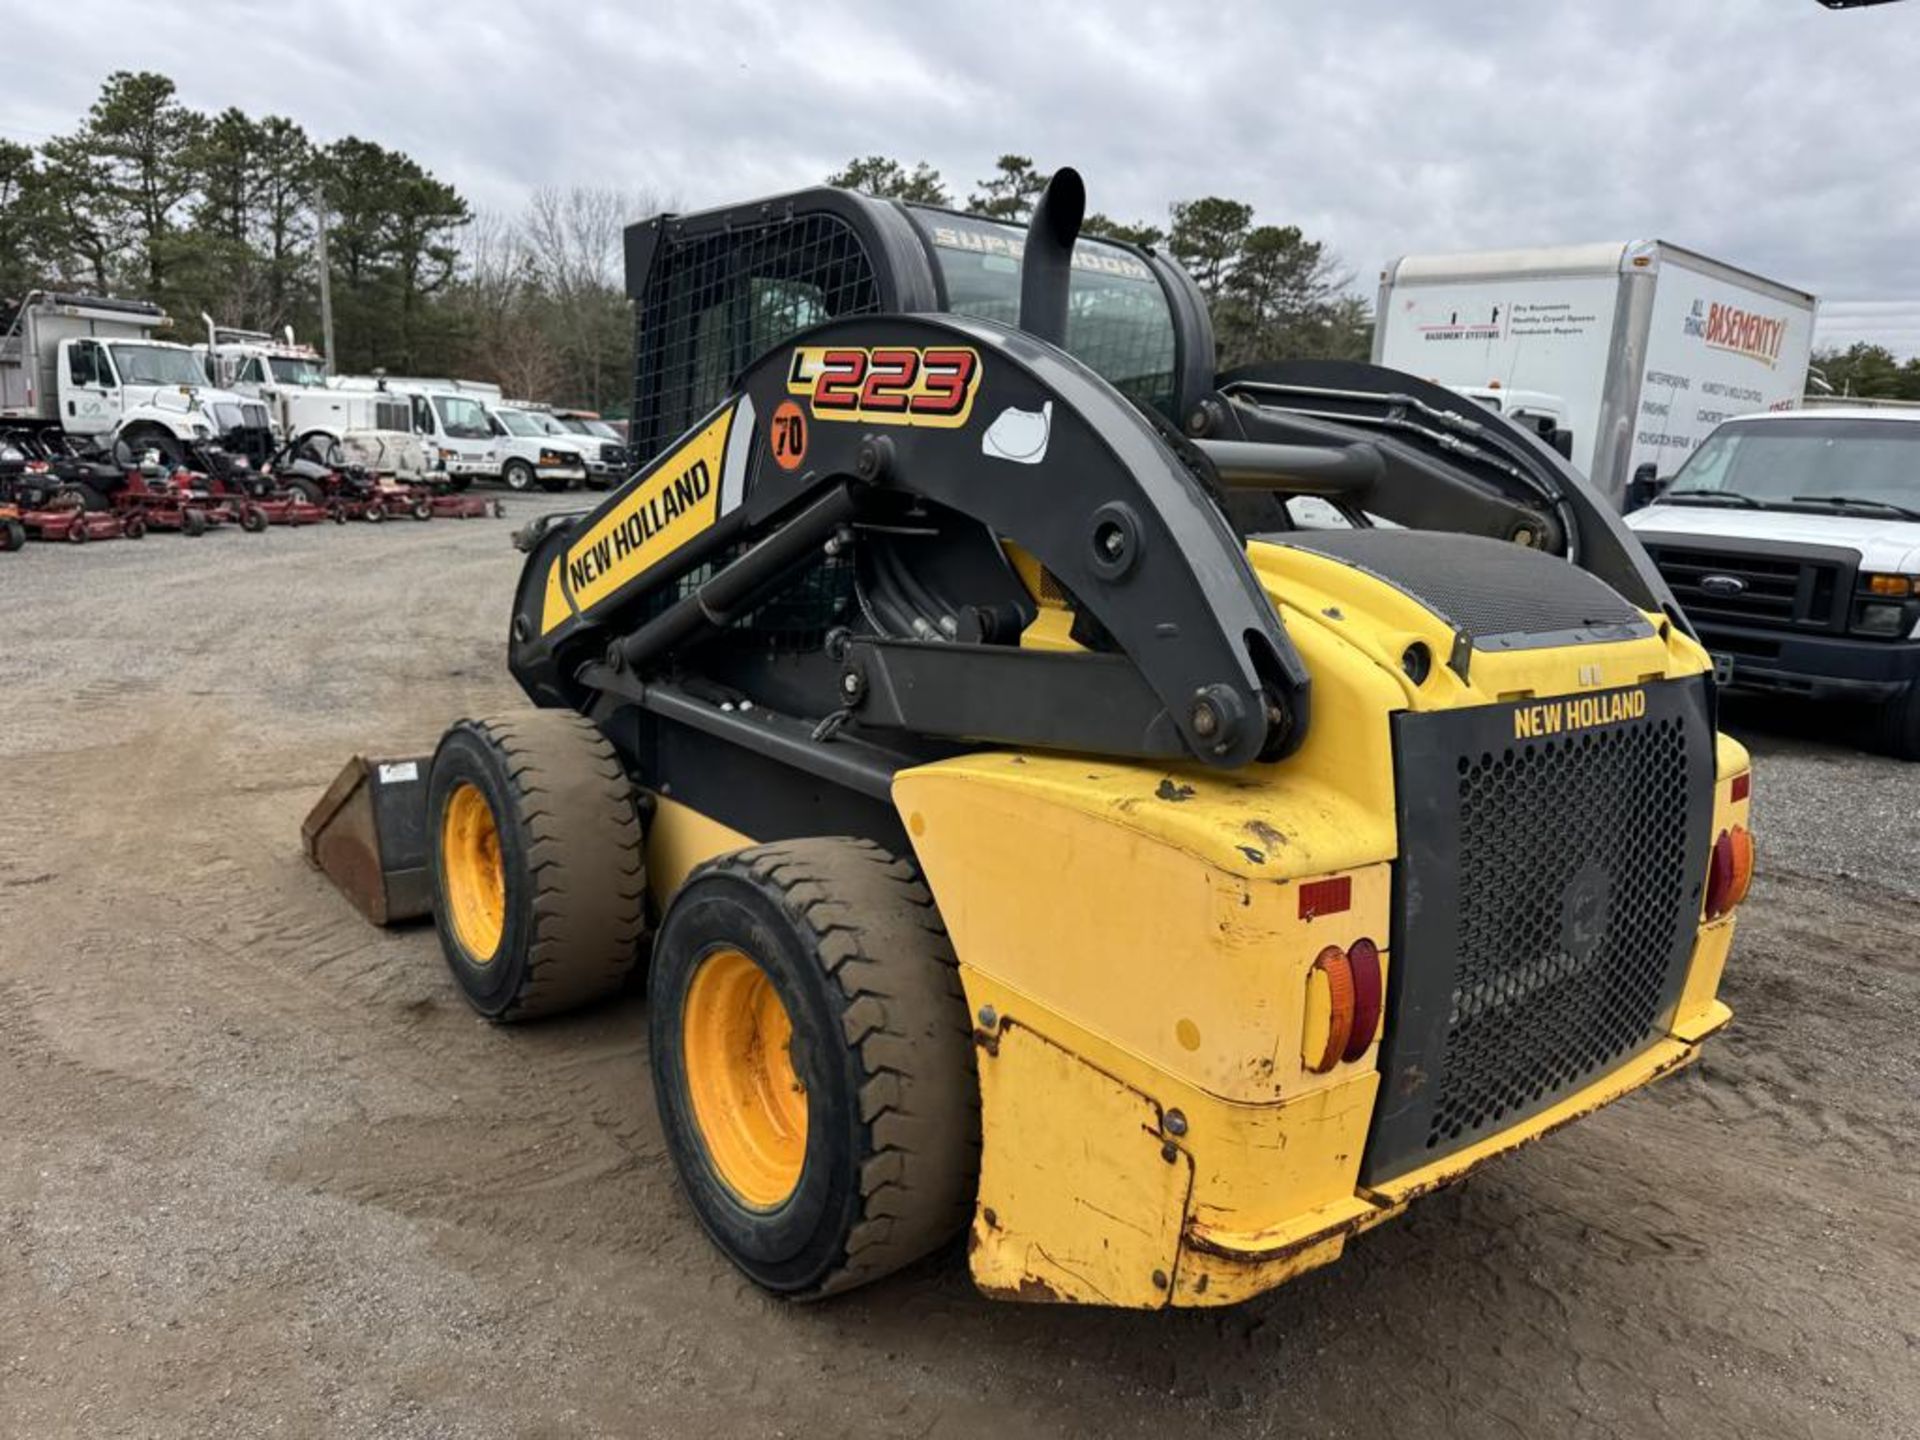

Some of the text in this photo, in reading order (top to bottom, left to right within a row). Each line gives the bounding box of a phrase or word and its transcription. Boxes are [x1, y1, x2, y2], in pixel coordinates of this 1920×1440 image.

[934, 227, 1025, 257] SUPE
[789, 348, 981, 420] L223
[775, 415, 804, 457] 70
[569, 458, 711, 594] NEW HOLLAND
[1514, 689, 1646, 739] NEW HOLLAND
